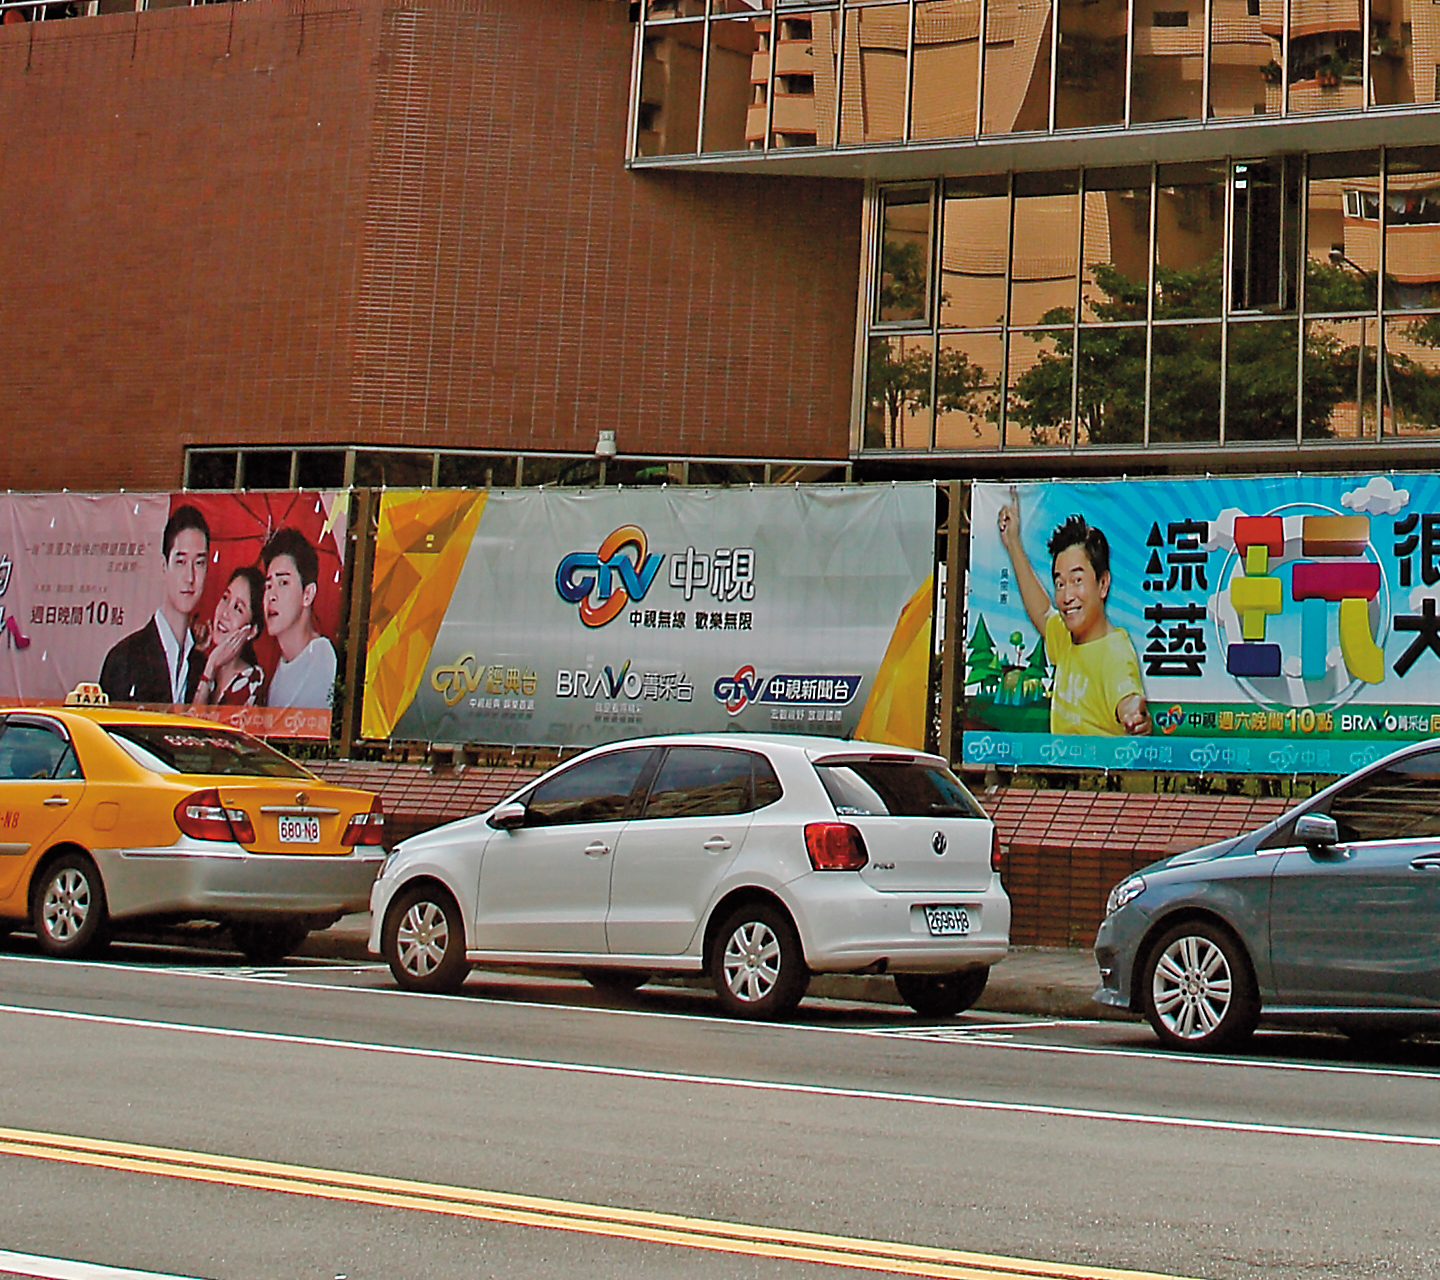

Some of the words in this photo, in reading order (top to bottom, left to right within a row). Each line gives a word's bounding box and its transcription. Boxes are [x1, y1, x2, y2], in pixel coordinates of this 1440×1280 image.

[668, 545, 756, 602] 中視
[1142, 518, 1209, 677] 綜藝
[1226, 514, 1385, 684] 玩
[30, 600, 125, 626] 週日晚間10點
[629, 610, 686, 629] 中視無線
[694, 611, 753, 630] 歡樂無限
[486, 665, 538, 696] 經典台
[556, 658, 643, 700] BRAVO
[769, 678, 850, 701] 中視新聞台
[76, 693, 106, 704] TAXI
[1188, 713, 1217, 729] 中視
[1218, 707, 1335, 734] 週六晚間10點
[1341, 709, 1397, 732] BRAVO
